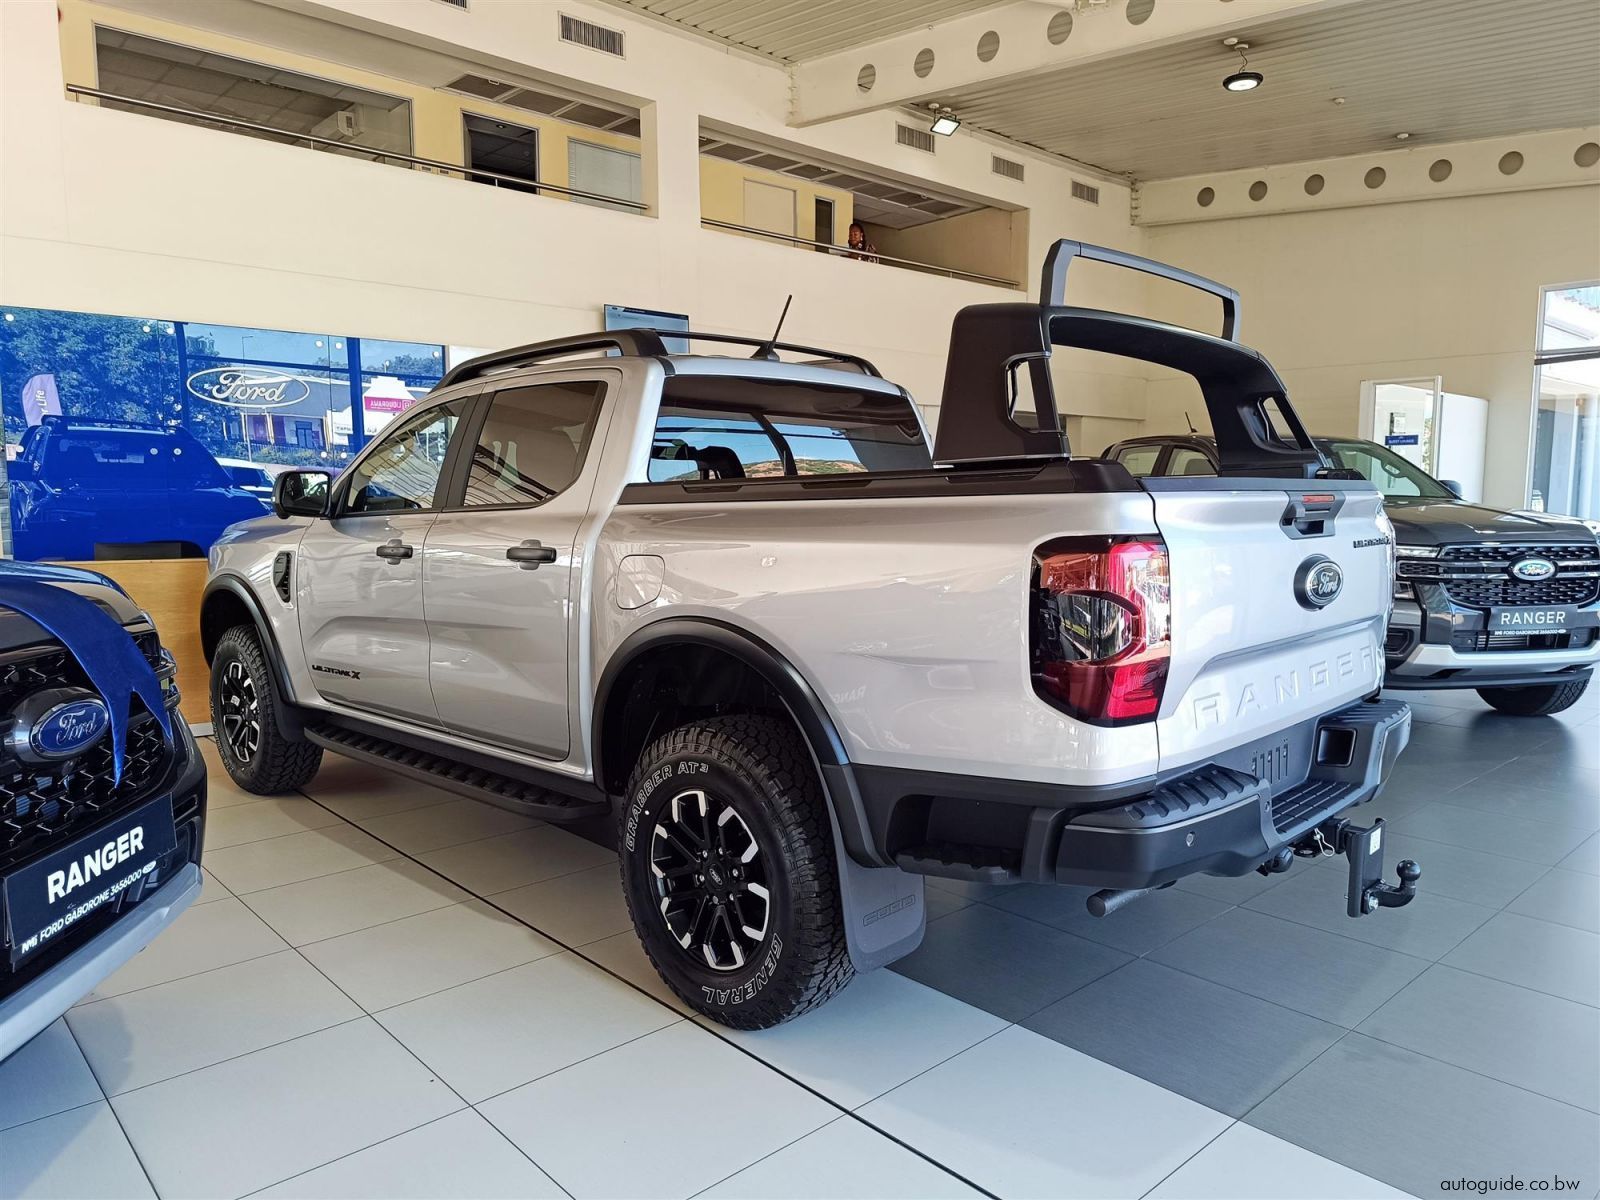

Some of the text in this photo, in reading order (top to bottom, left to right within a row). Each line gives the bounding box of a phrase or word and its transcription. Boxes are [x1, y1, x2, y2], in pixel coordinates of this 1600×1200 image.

[36, 390, 47, 407] Life
[212, 372, 286, 402] Ford
[1318, 571, 1339, 594] Ford
[1501, 611, 1566, 625] RANGER
[351, 670, 361, 680] X
[1193, 645, 1373, 729] RANGER
[56, 709, 97, 745] Ford
[626, 764, 672, 852] GRABBER
[47, 826, 144, 904] RANGER
[40, 919, 64, 942] FORD
[65, 889, 109, 925] GABORONE
[110, 869, 141, 896] 3656000
[702, 933, 783, 1005] GENERAL
